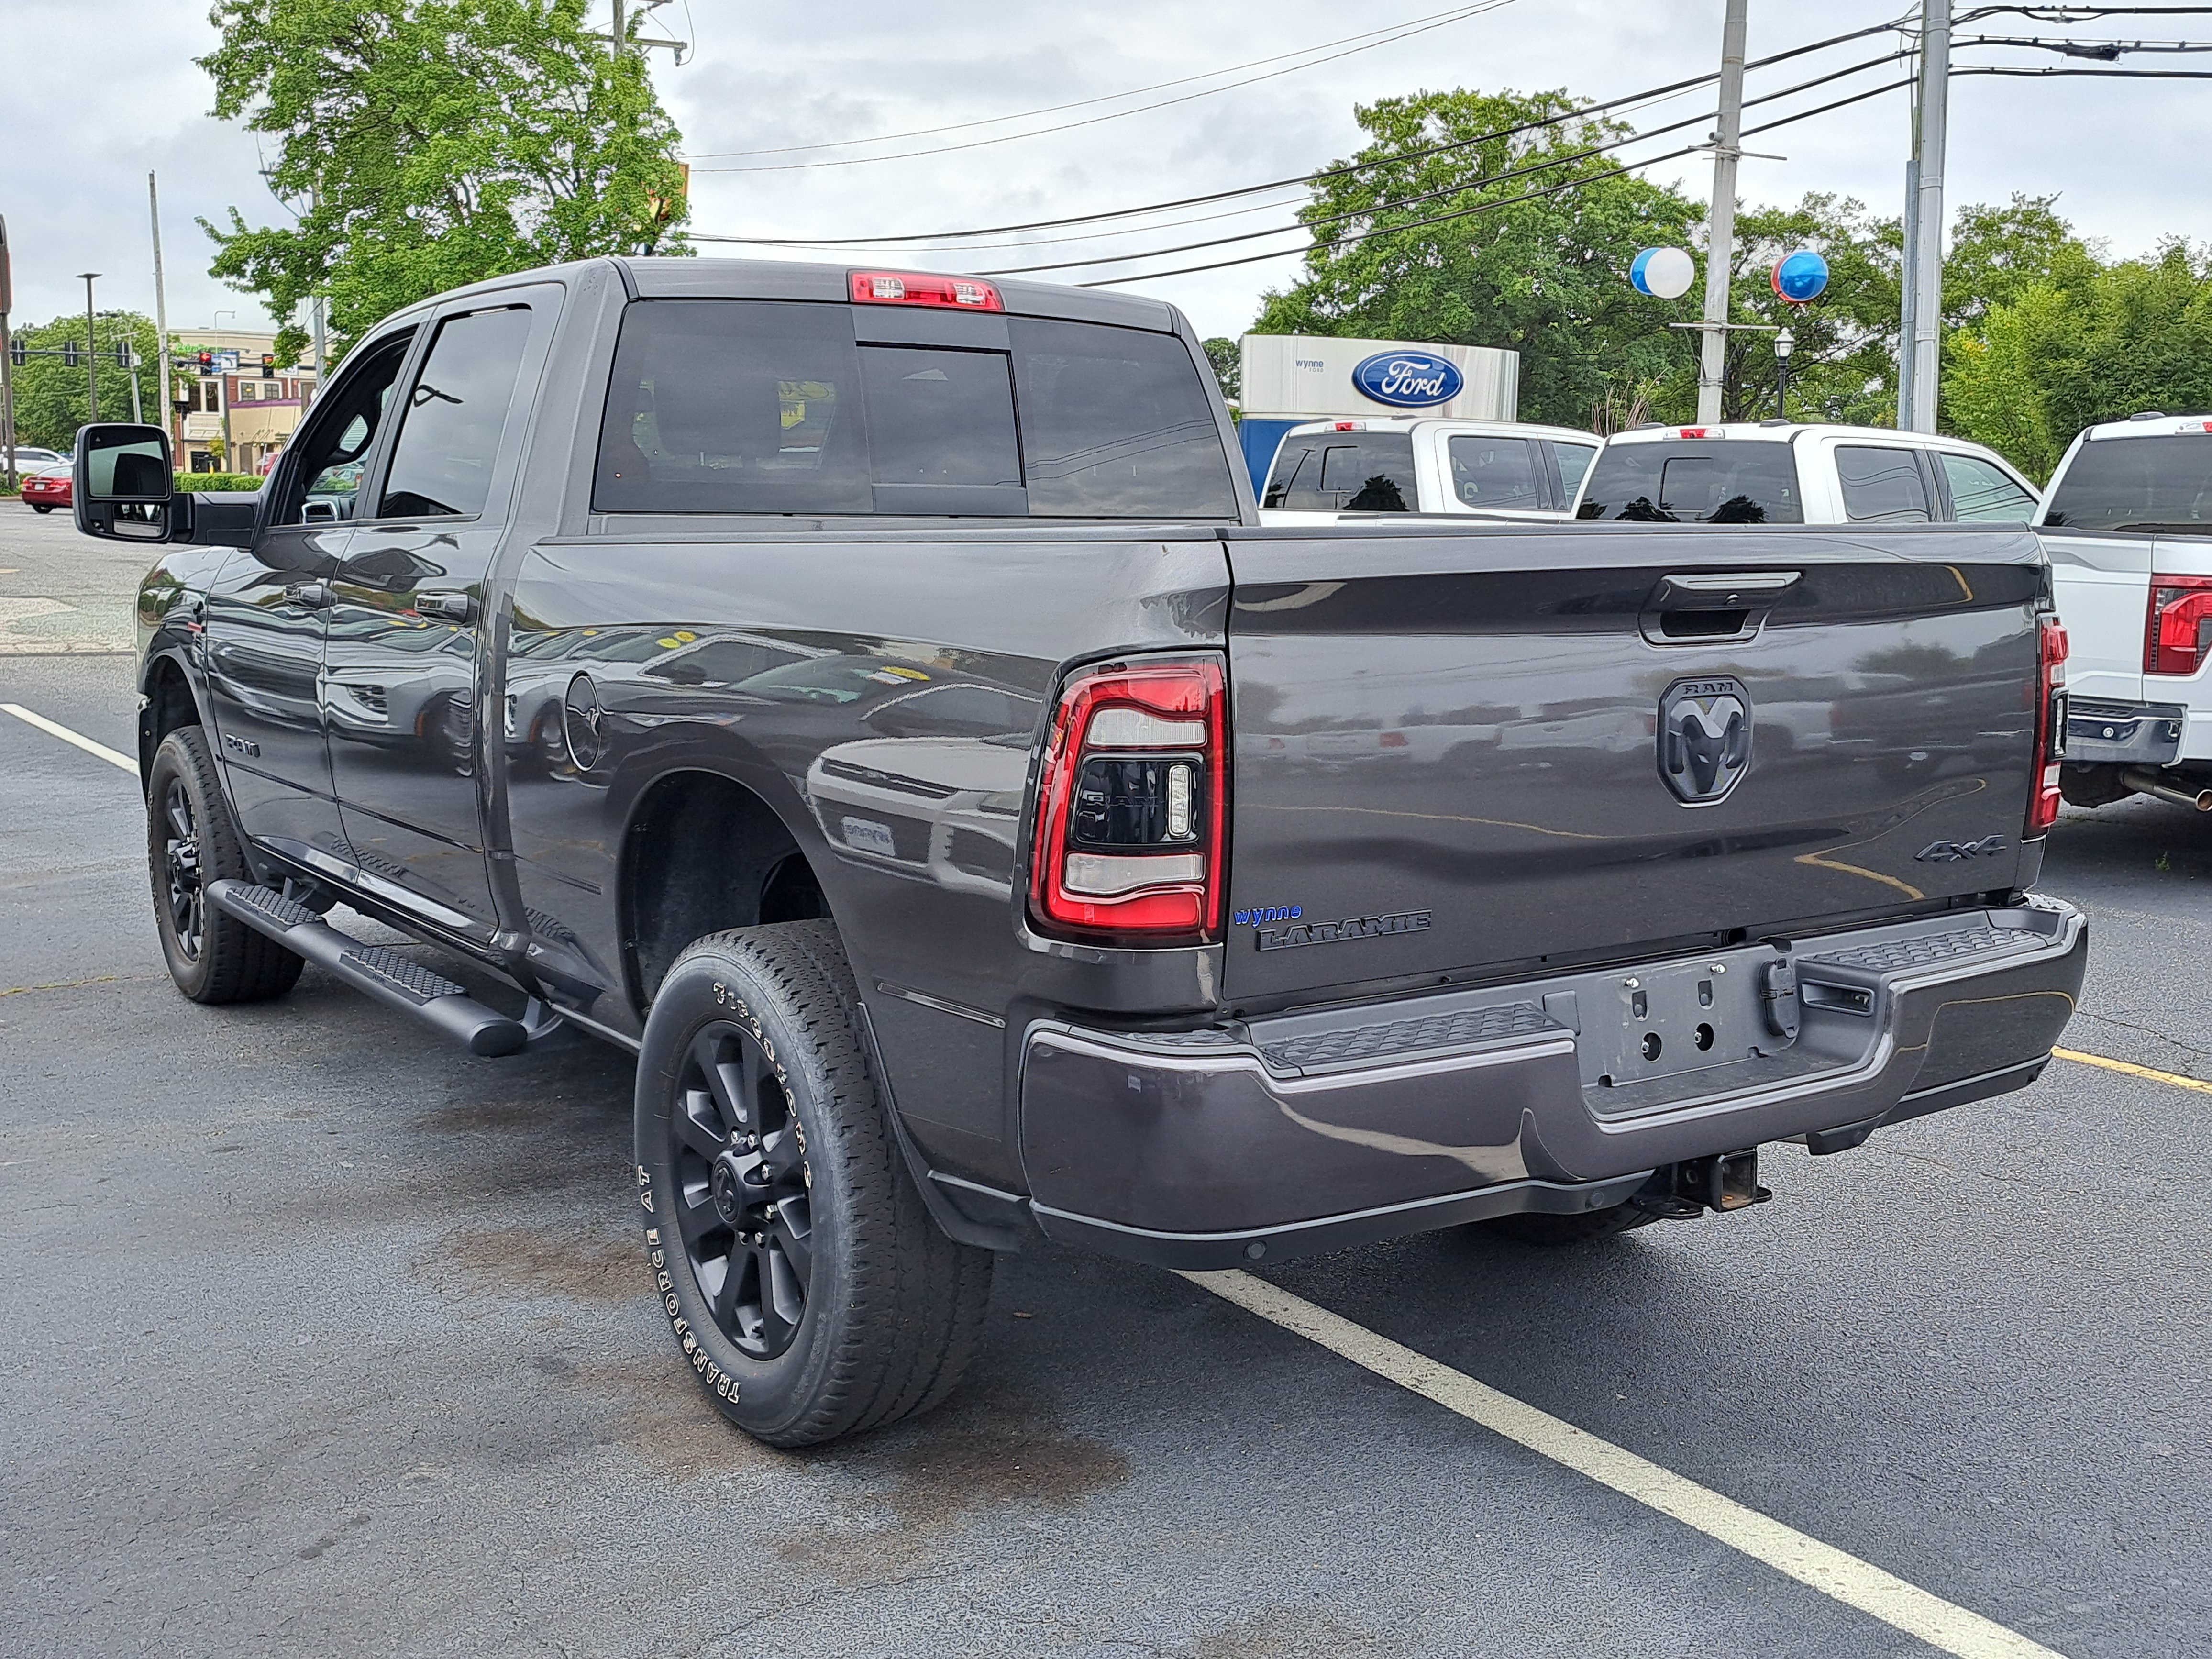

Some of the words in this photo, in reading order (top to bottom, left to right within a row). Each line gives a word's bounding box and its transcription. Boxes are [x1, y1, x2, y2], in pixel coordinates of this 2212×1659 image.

[1295, 359, 1324, 369] wynne
[1381, 360, 1445, 397] Ford
[1682, 681, 1734, 695] RAM
[225, 733, 261, 758] RAM
[1233, 904, 1303, 928] wynne
[1255, 909, 1432, 952] LARAMIE
[636, 1165, 656, 1214] AT
[646, 1228, 741, 1405] TRANSFORCE
